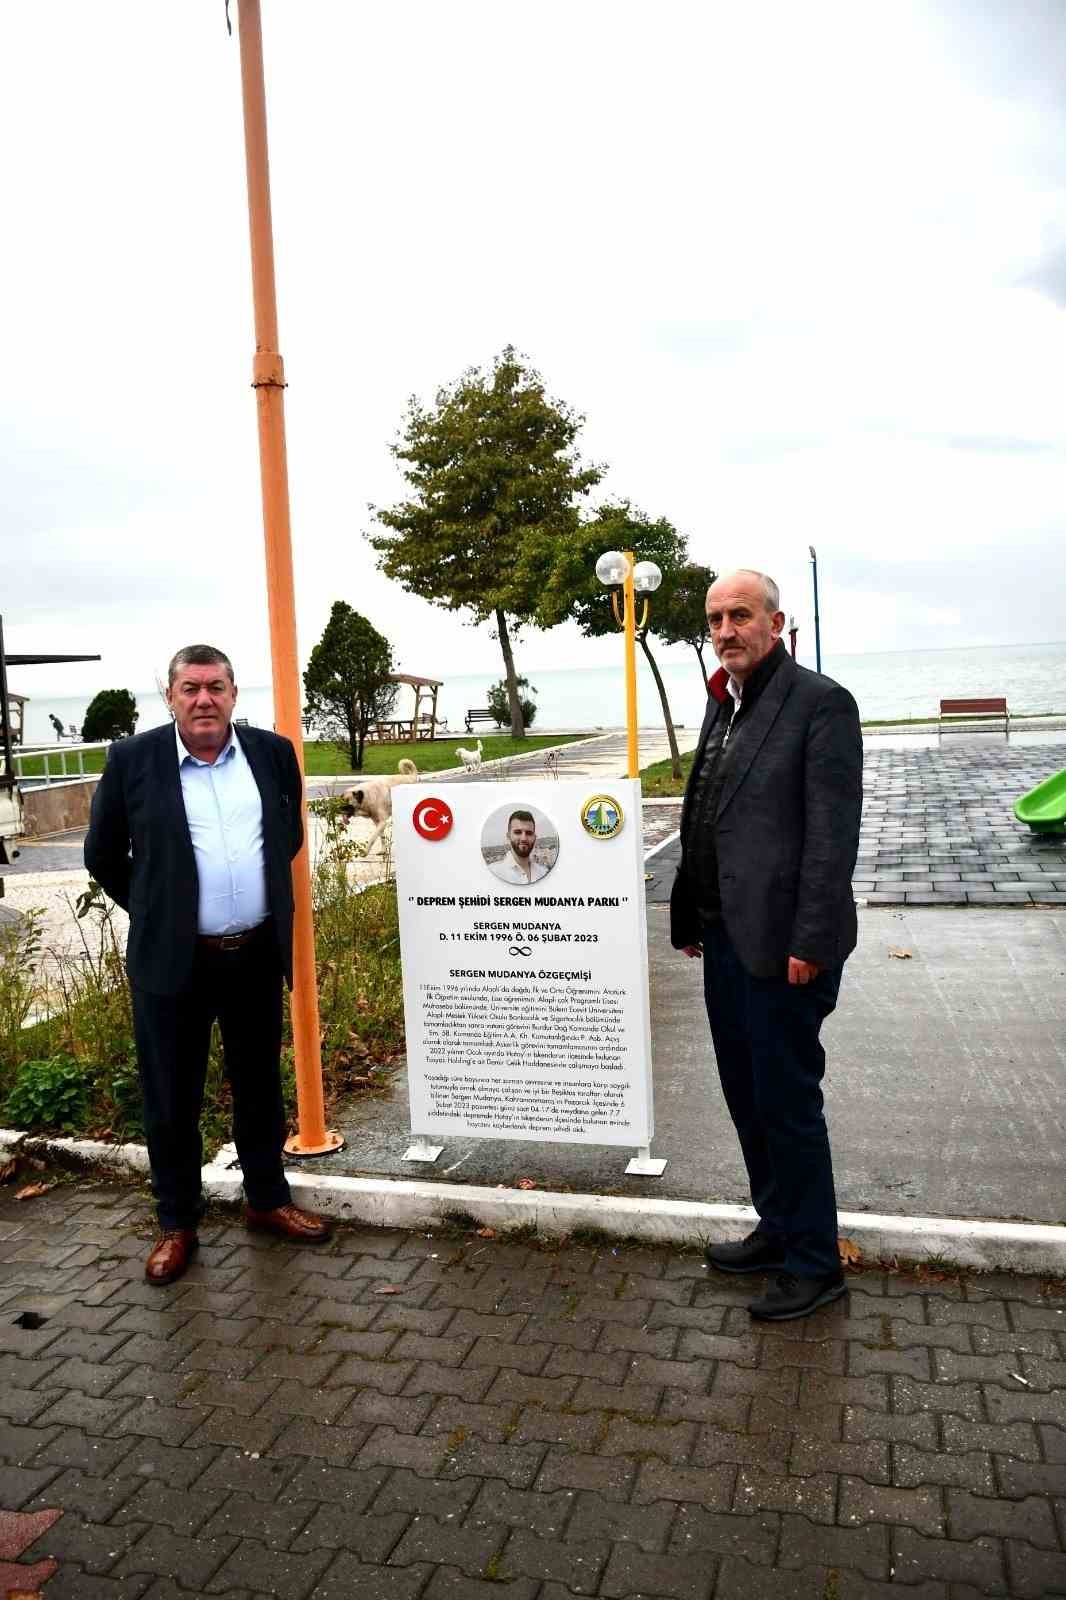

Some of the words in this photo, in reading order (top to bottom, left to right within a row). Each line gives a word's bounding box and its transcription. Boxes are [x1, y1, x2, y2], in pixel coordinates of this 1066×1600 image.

[417, 896, 456, 906] DEPREM
[458, 894, 491, 909] ŞEHİDİ
[493, 896, 531, 907] SERGEN
[534, 896, 585, 907] MUDANYA
[587, 896, 620, 907] PARKI
[473, 922, 510, 930] SERGEN
[512, 922, 562, 931] MUDANYA
[439, 932, 449, 941] D.
[451, 933, 461, 941] 11
[464, 931, 487, 941] EKİM
[490, 933, 513, 942] 1996
[515, 932, 526, 942] Ö.
[527, 933, 540, 942] 06
[542, 934, 572, 943] ŞUBAT
[574, 934, 599, 942] 2023
[449, 969, 486, 978] SERGEN
[488, 970, 537, 979] MUDANYA
[538, 970, 592, 982] ÖZGEÇMİŞİ
[443, 983, 459, 991] 1996
[430, 1047, 446, 1056] 2022
